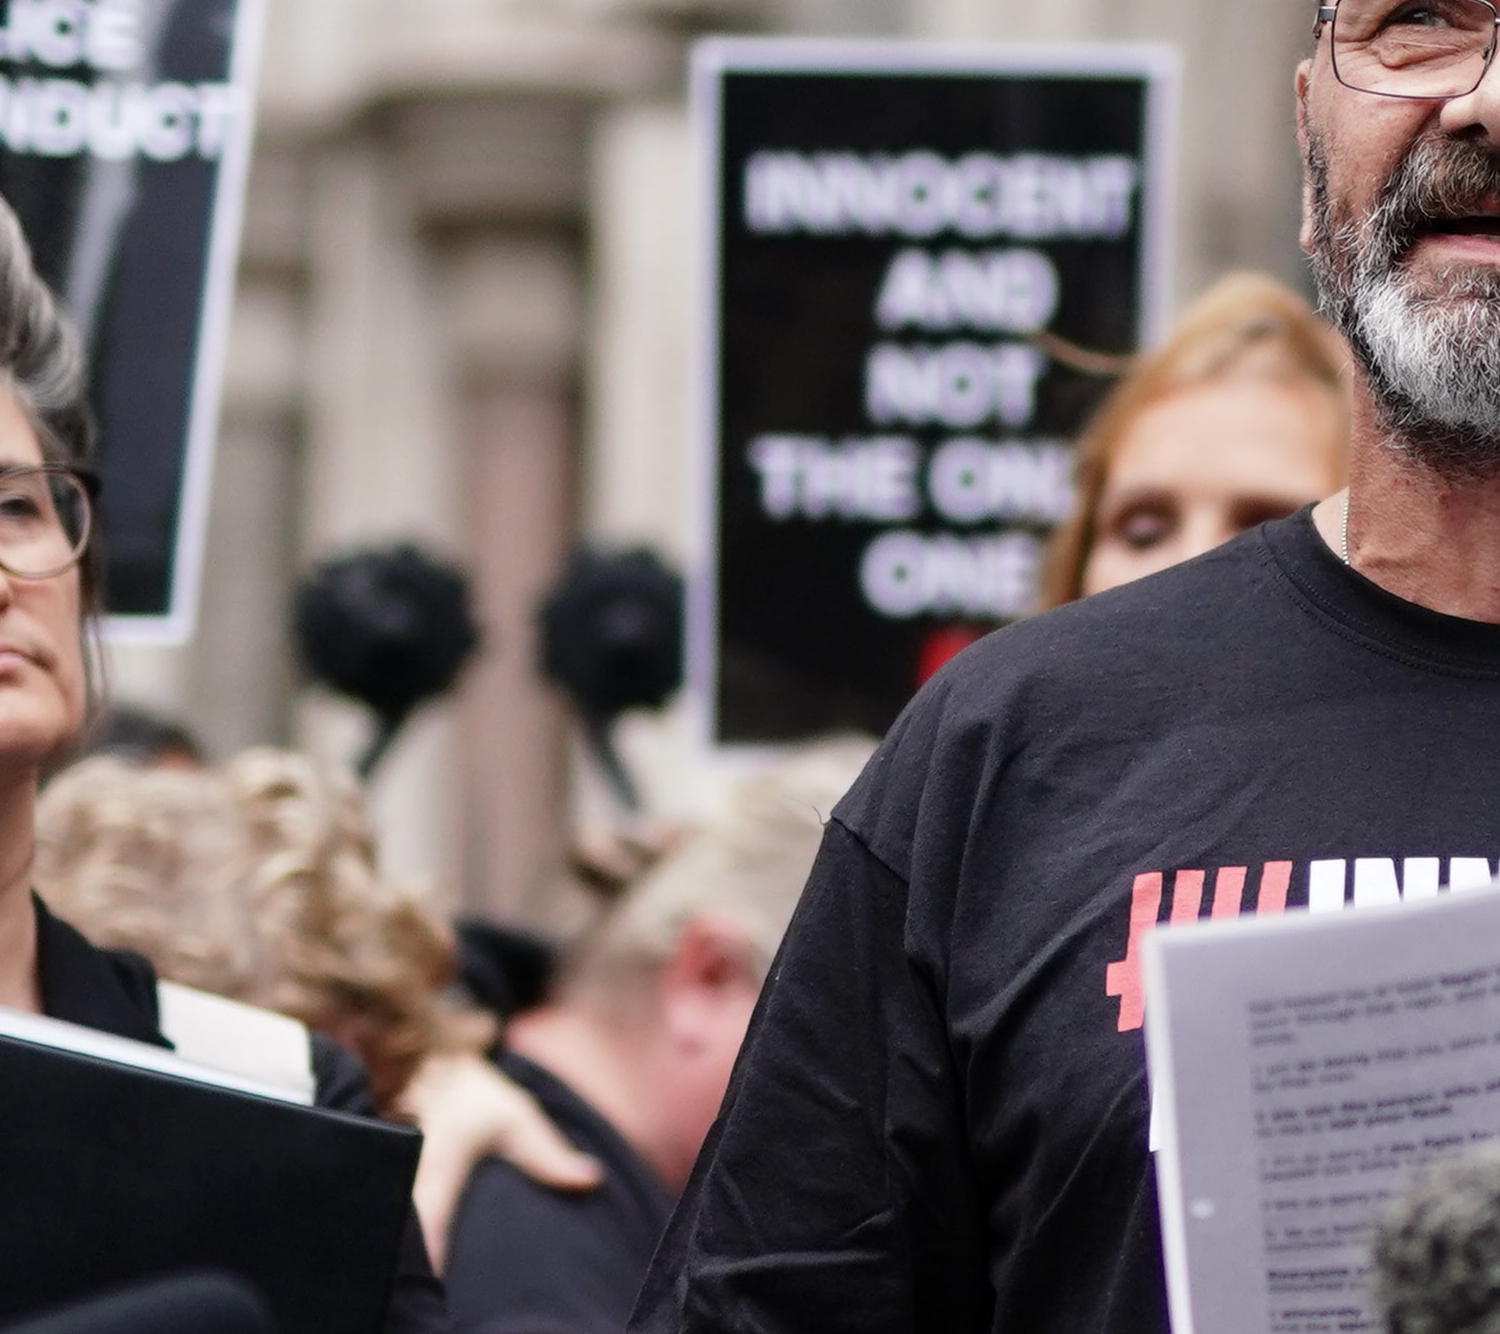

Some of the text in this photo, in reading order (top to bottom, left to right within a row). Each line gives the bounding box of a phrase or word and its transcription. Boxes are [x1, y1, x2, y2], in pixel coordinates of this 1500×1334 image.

[744, 151, 1139, 239] INNOCENT
[876, 247, 1059, 335] AND
[866, 342, 1042, 427] NOT
[750, 434, 919, 522] THE
[861, 530, 1042, 621] ONE
